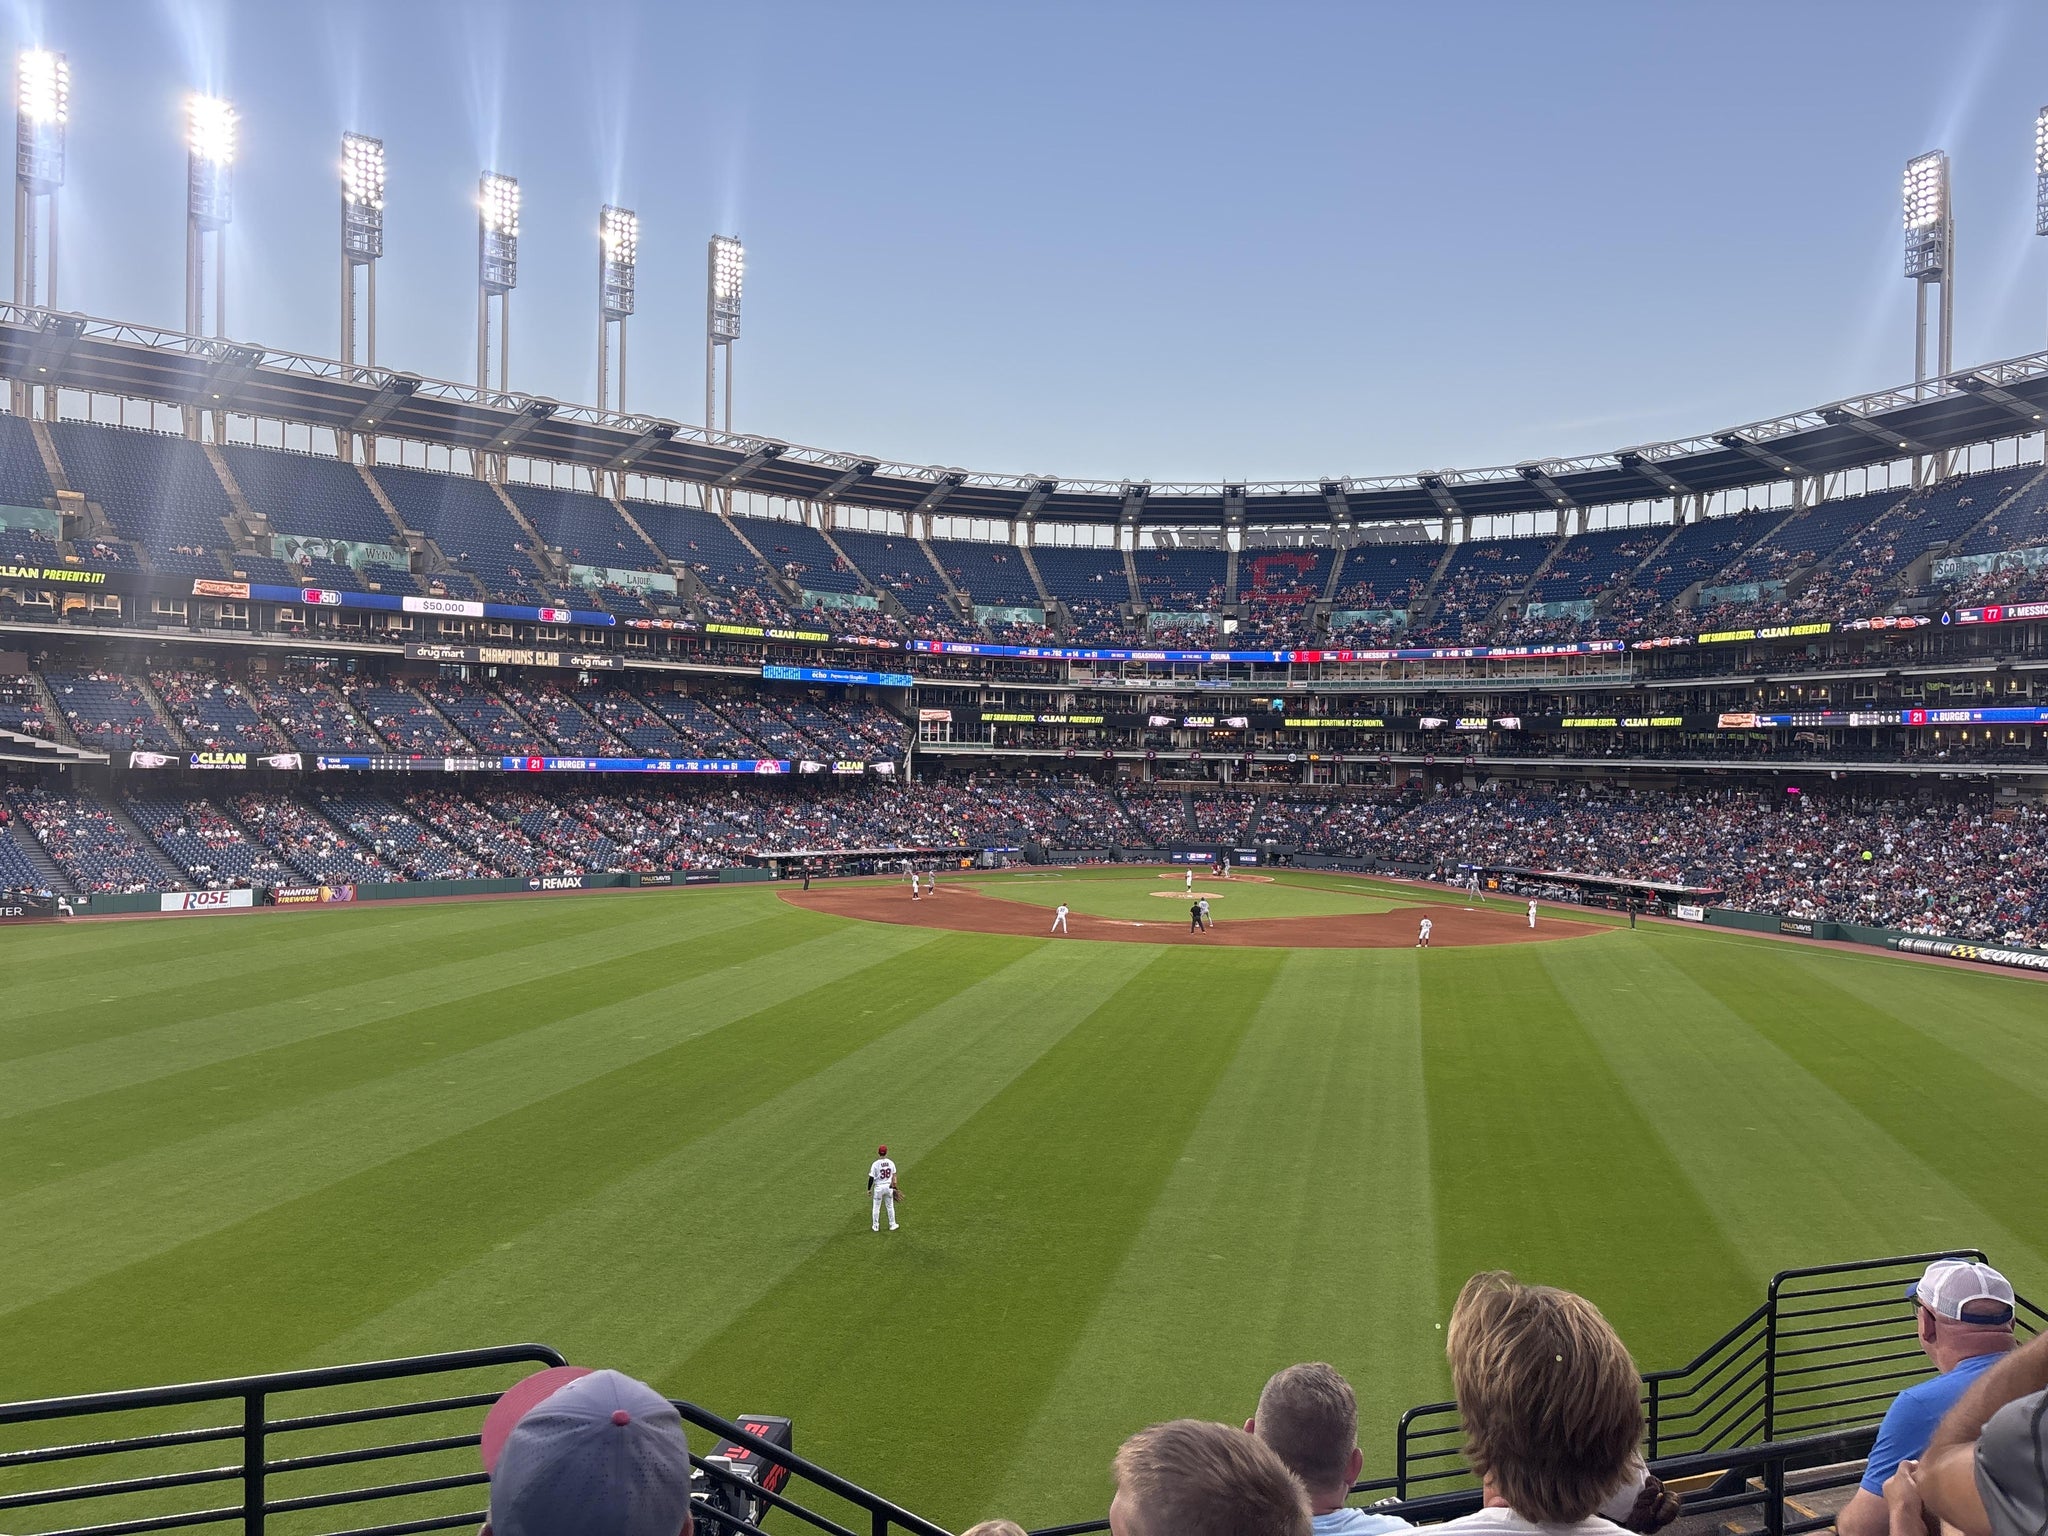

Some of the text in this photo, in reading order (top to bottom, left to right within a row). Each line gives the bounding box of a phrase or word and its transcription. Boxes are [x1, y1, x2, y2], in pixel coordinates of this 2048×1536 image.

[366, 547, 396, 560] WYNN
[1937, 562, 1968, 574] SCORE
[42, 569, 90, 582] PREVENTS
[91, 573, 105, 583] IT!
[626, 574, 650, 585] LAJOIE
[423, 601, 465, 612] $50,000
[1988, 609, 1998, 619] 77
[2008, 607, 2016, 617] P.
[770, 629, 795, 639] CLEAN
[1761, 627, 1789, 638] CLEAN
[933, 643, 940, 651] 21
[417, 648, 464, 659] drug mart
[480, 649, 559, 665] CHAMPIONS CLUB
[571, 657, 612, 667] drug mart
[1624, 718, 1648, 726] CLEAN
[1913, 712, 1922, 721] 21
[1931, 713, 1939, 721] J.
[1940, 712, 1970, 721] BURGER
[1321, 719, 1344, 727] STARTING
[199, 753, 246, 764] CLEAN
[531, 760, 540, 768] 21
[550, 760, 557, 768] J.
[558, 760, 585, 768] BURGER
[711, 762, 718, 770] 14
[279, 888, 318, 896] PHANTOM
[183, 892, 229, 909] ROSE
[278, 895, 318, 903] FIREWORKS
[880, 1168, 891, 1179] 38
